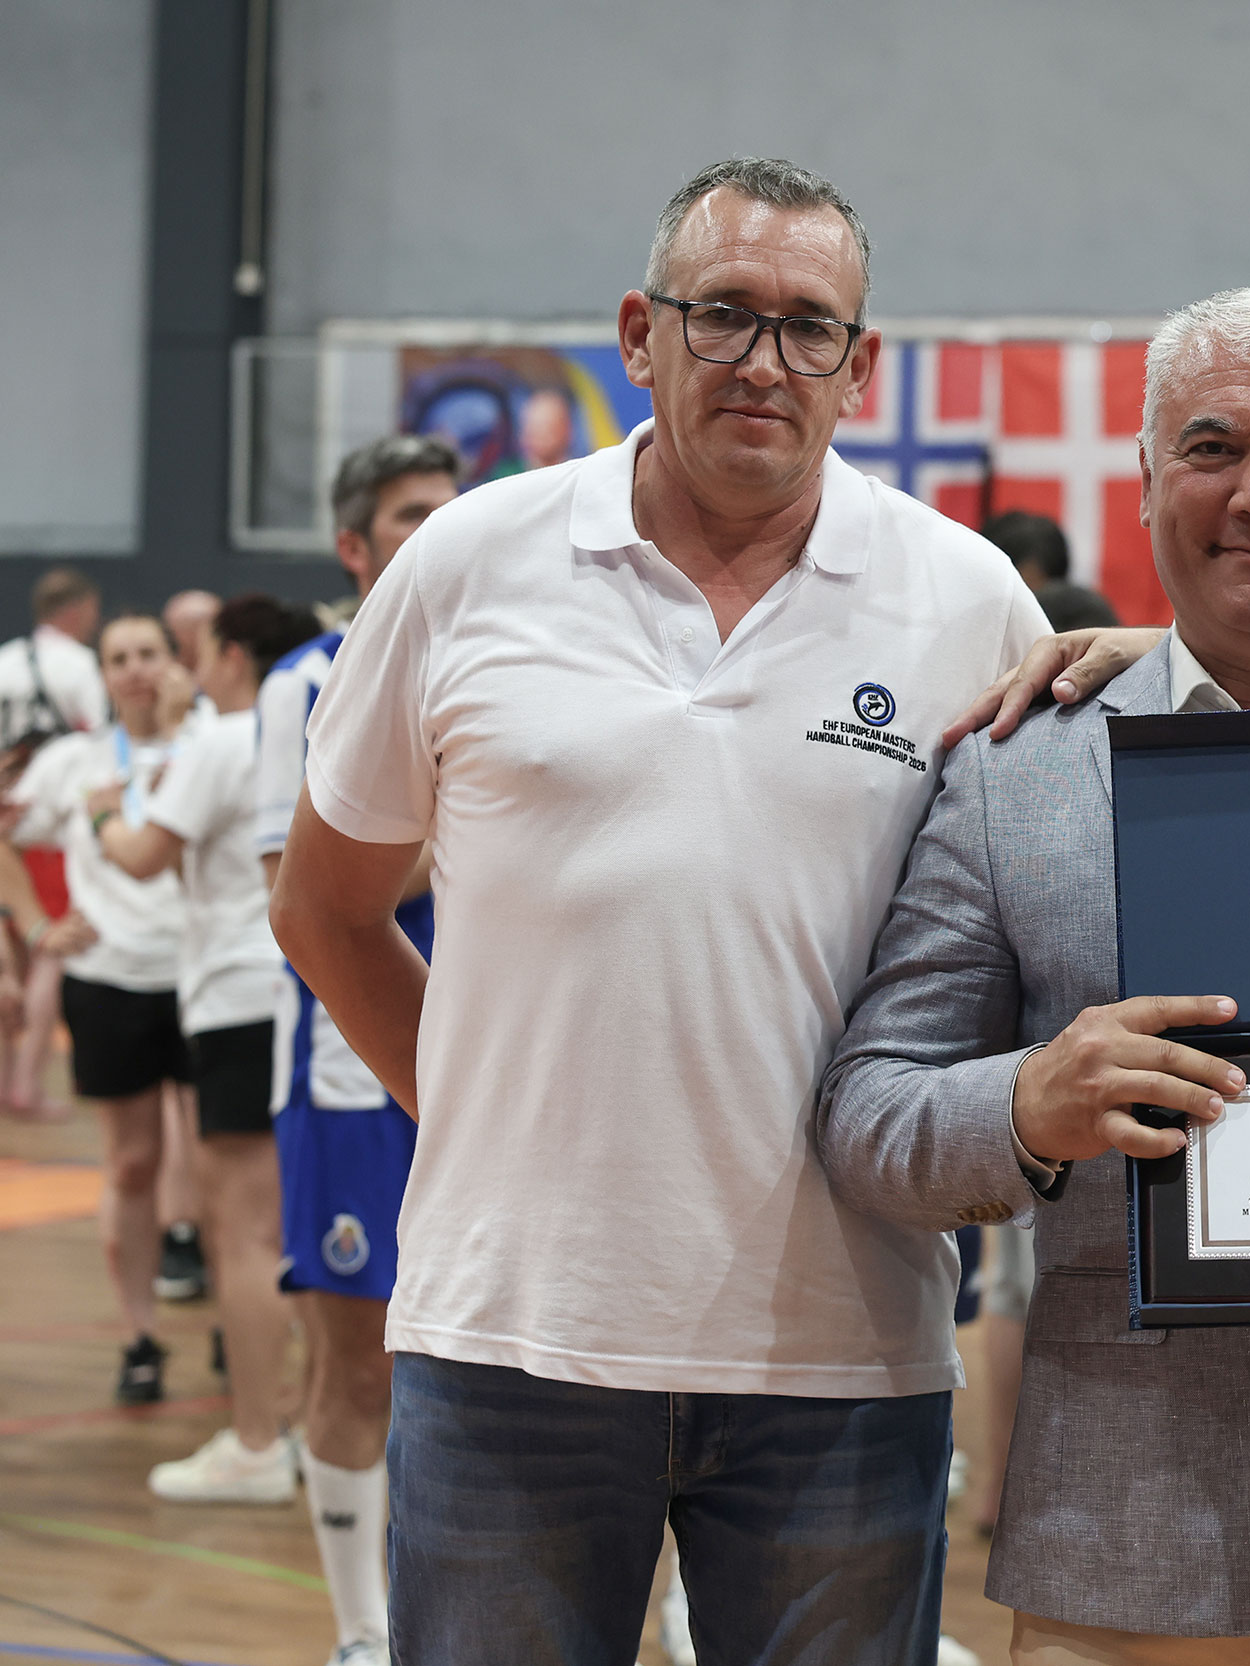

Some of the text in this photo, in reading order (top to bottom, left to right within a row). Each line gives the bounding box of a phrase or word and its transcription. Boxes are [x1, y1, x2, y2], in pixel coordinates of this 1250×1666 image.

[806, 730, 927, 773] HANDBALL CHAMPIONSHIP 2026
[822, 719, 916, 754] EHF EUROPEAN MASTERS
